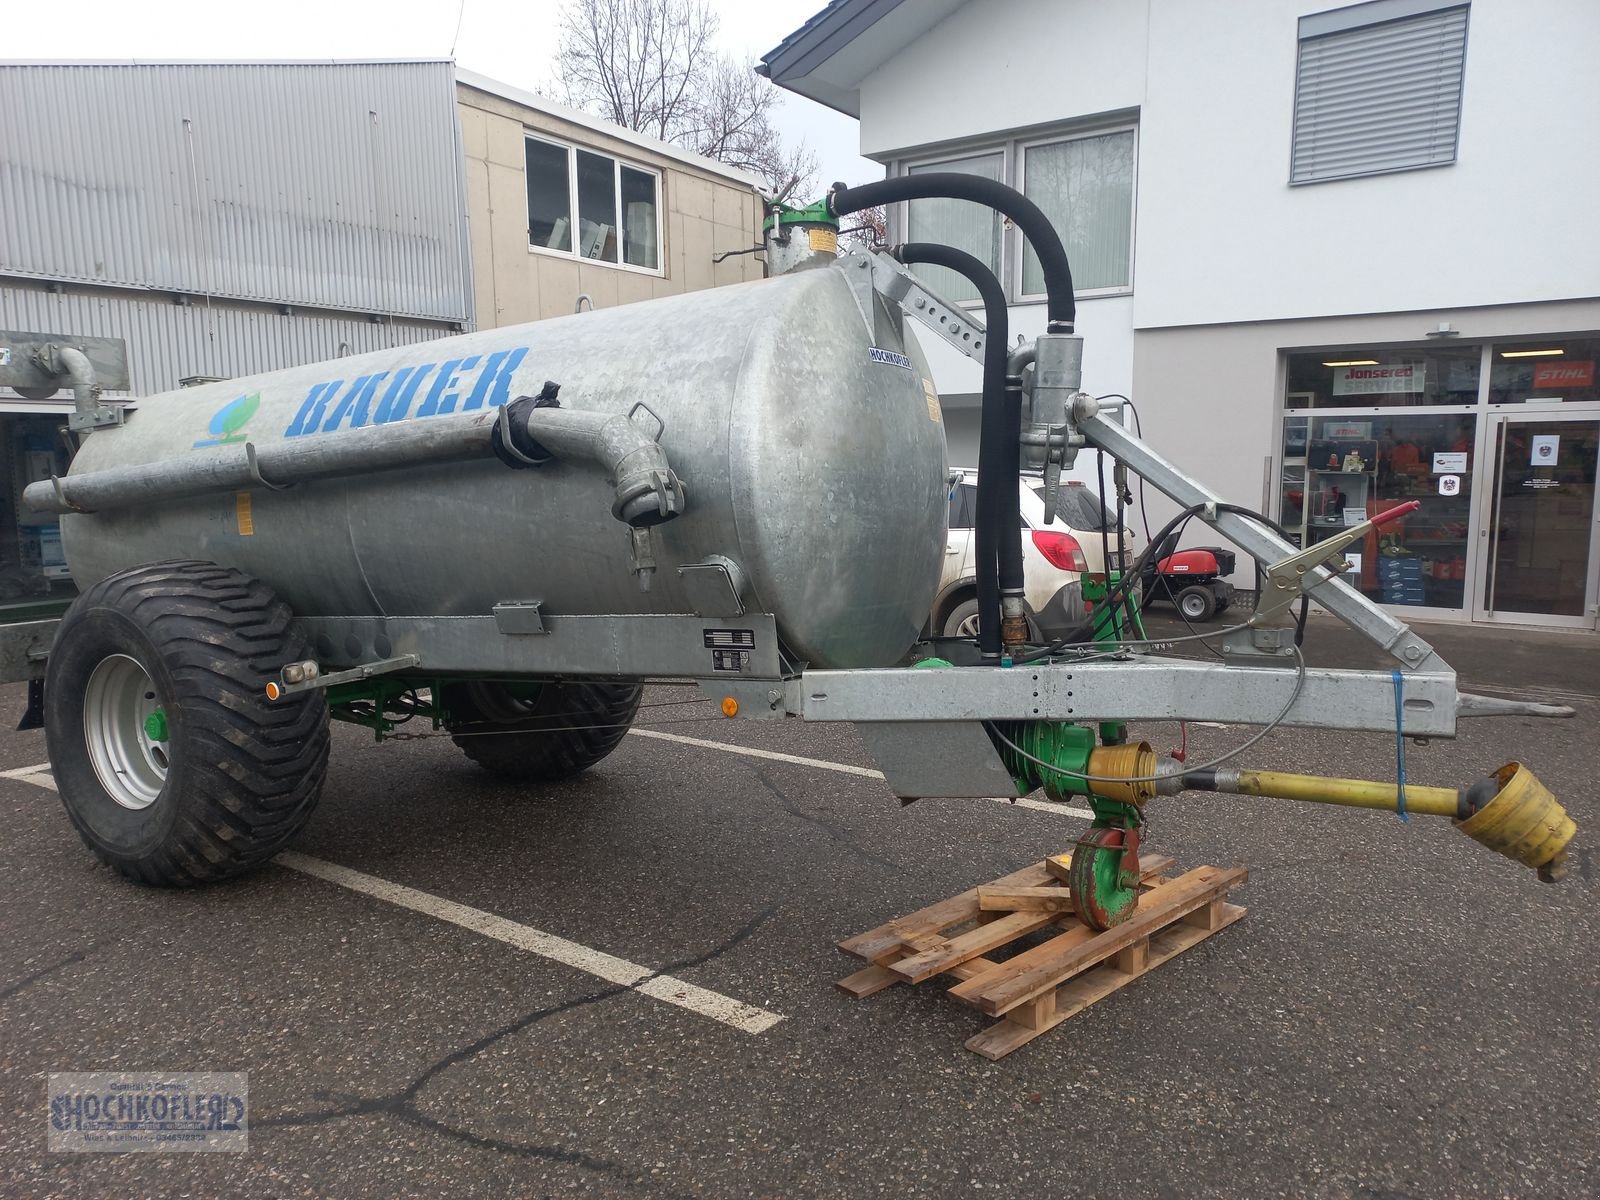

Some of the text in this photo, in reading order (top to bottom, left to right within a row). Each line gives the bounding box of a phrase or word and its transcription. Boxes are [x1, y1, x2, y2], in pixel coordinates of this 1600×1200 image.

[869, 348, 912, 369] HOCHKOFLER
[1345, 366, 1413, 379] Jonsered
[1538, 369, 1587, 380] STIHL
[284, 346, 529, 438] BAUER
